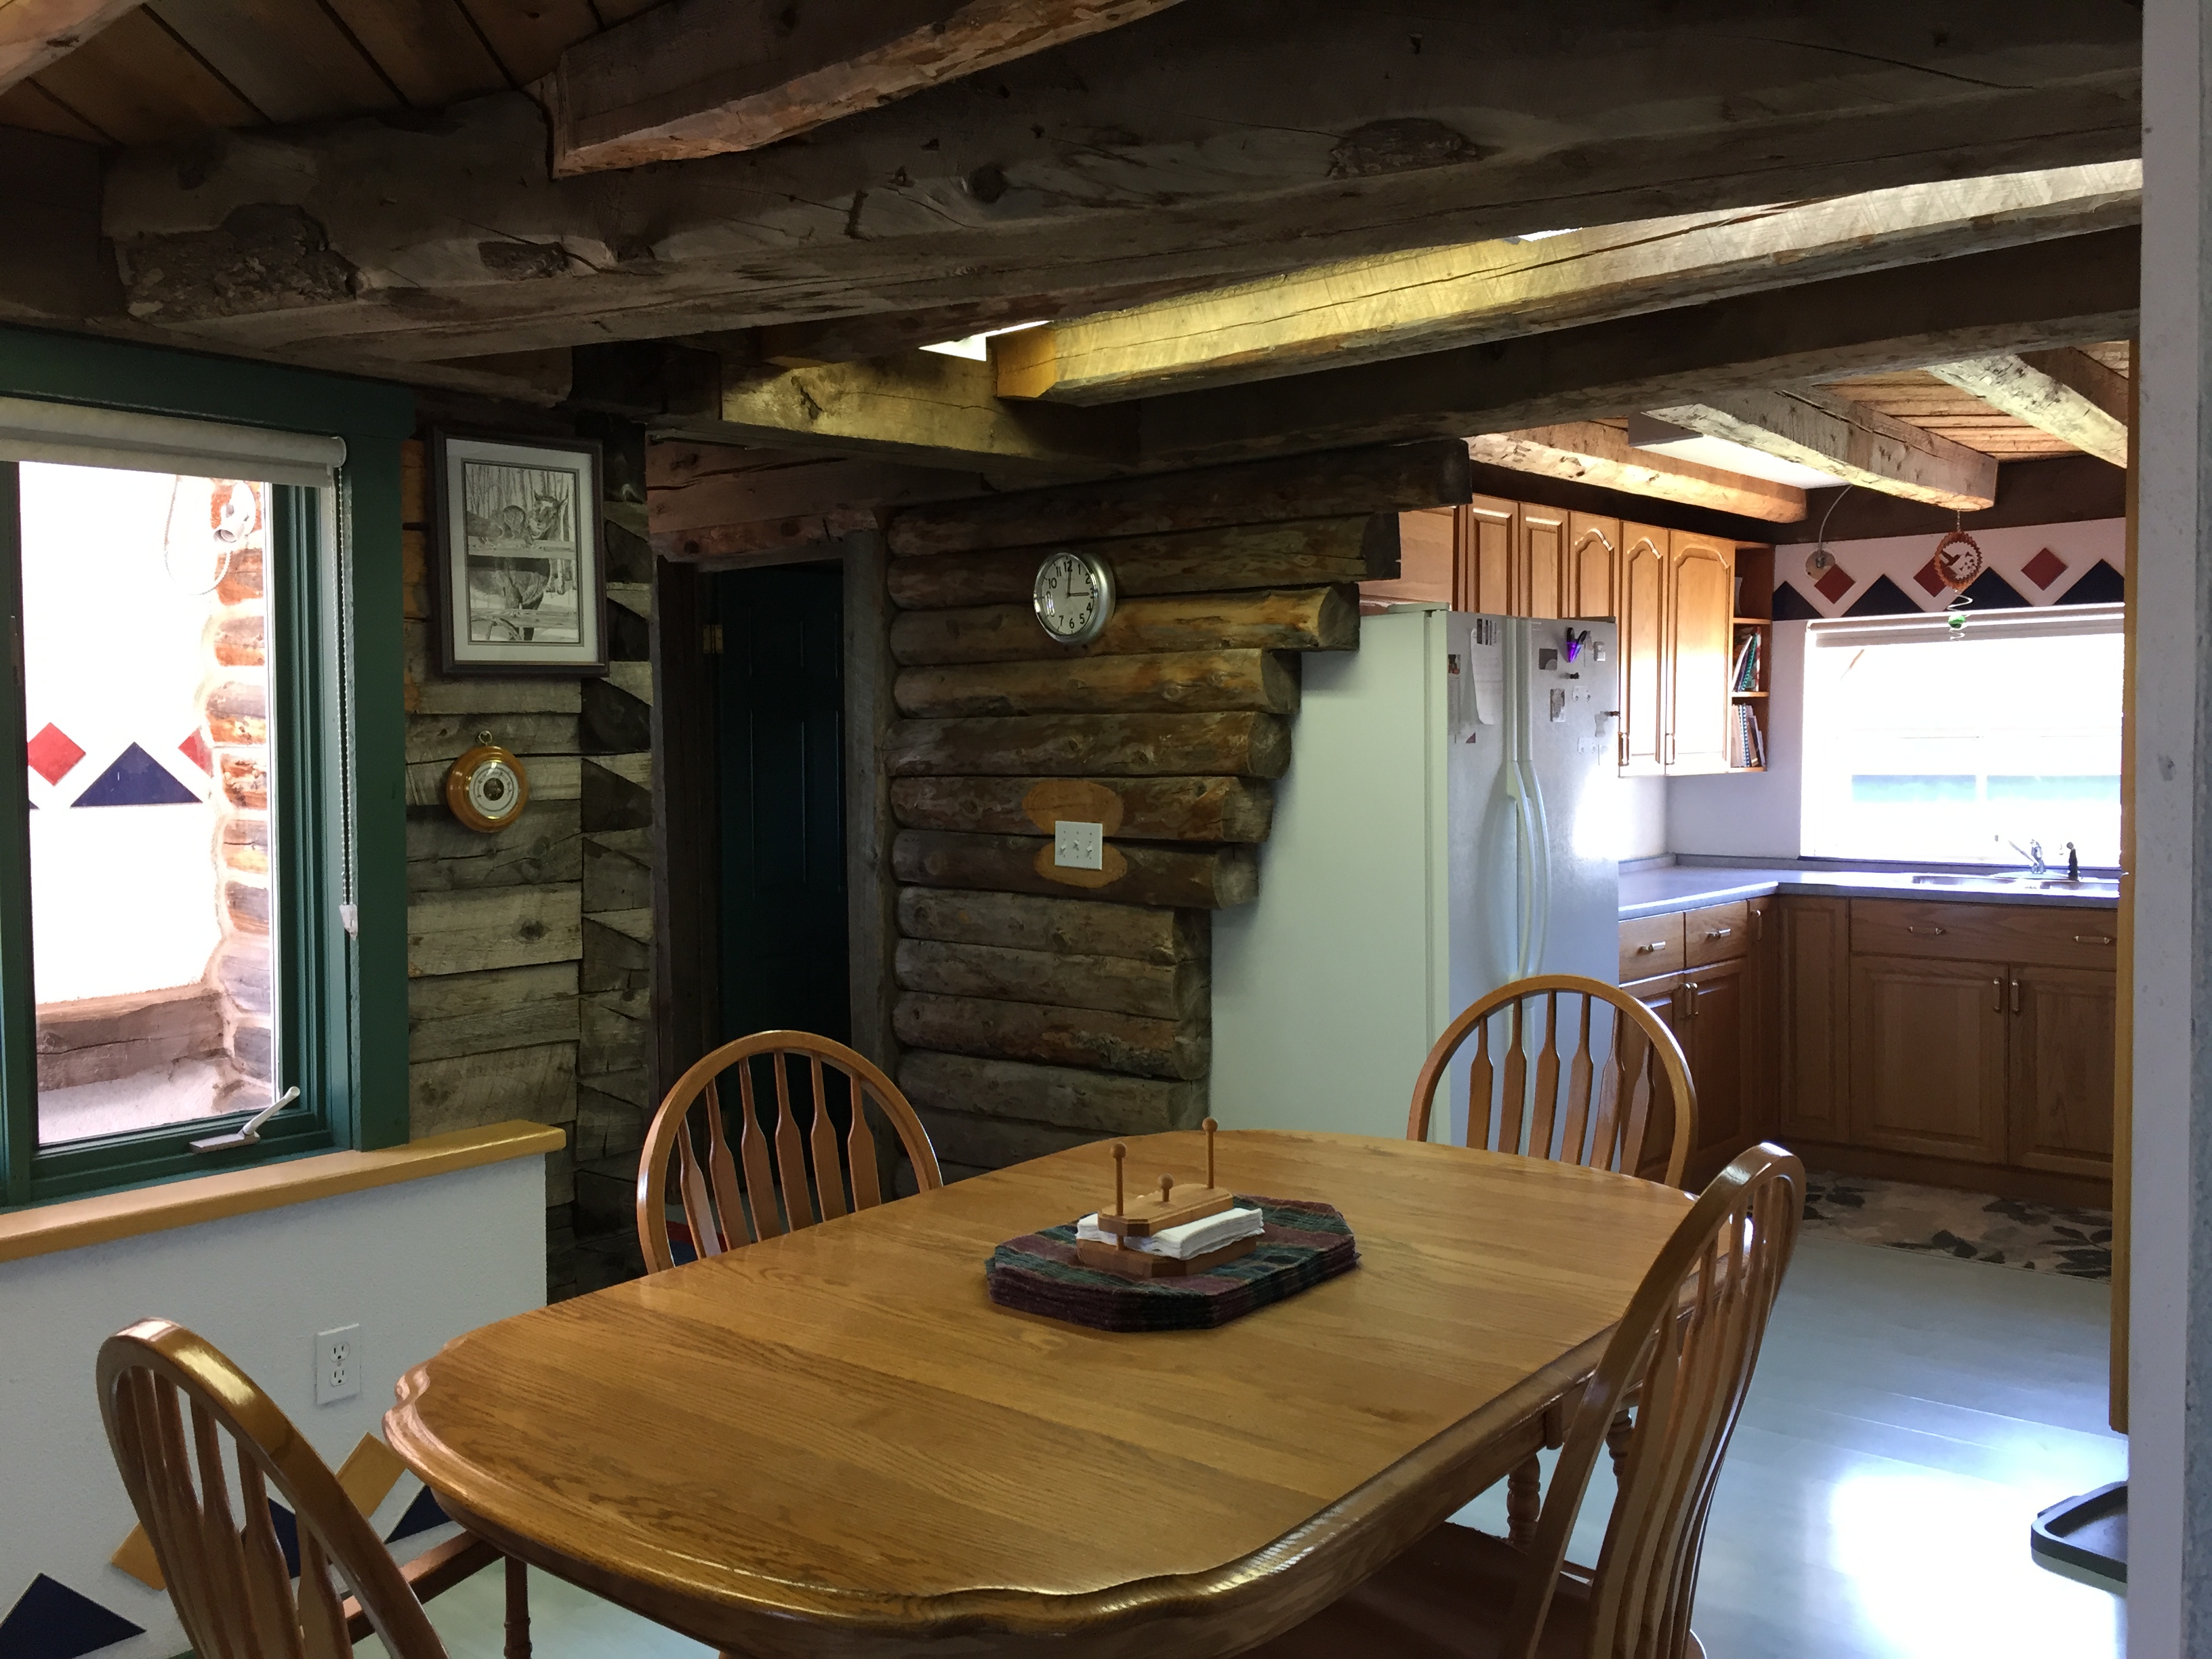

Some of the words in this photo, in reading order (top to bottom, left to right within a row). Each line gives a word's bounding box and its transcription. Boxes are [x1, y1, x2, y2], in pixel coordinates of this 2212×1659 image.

[1056, 566, 1062, 577] 11
[1063, 560, 1073, 572] 12
[1078, 564, 1081, 575] 1
[1048, 577, 1057, 589] 10
[1085, 573, 1090, 584] 2
[1086, 602, 1092, 613] 4
[1059, 615, 1064, 626] 7
[1069, 618, 1075, 629] 6
[1080, 613, 1085, 624] 5
